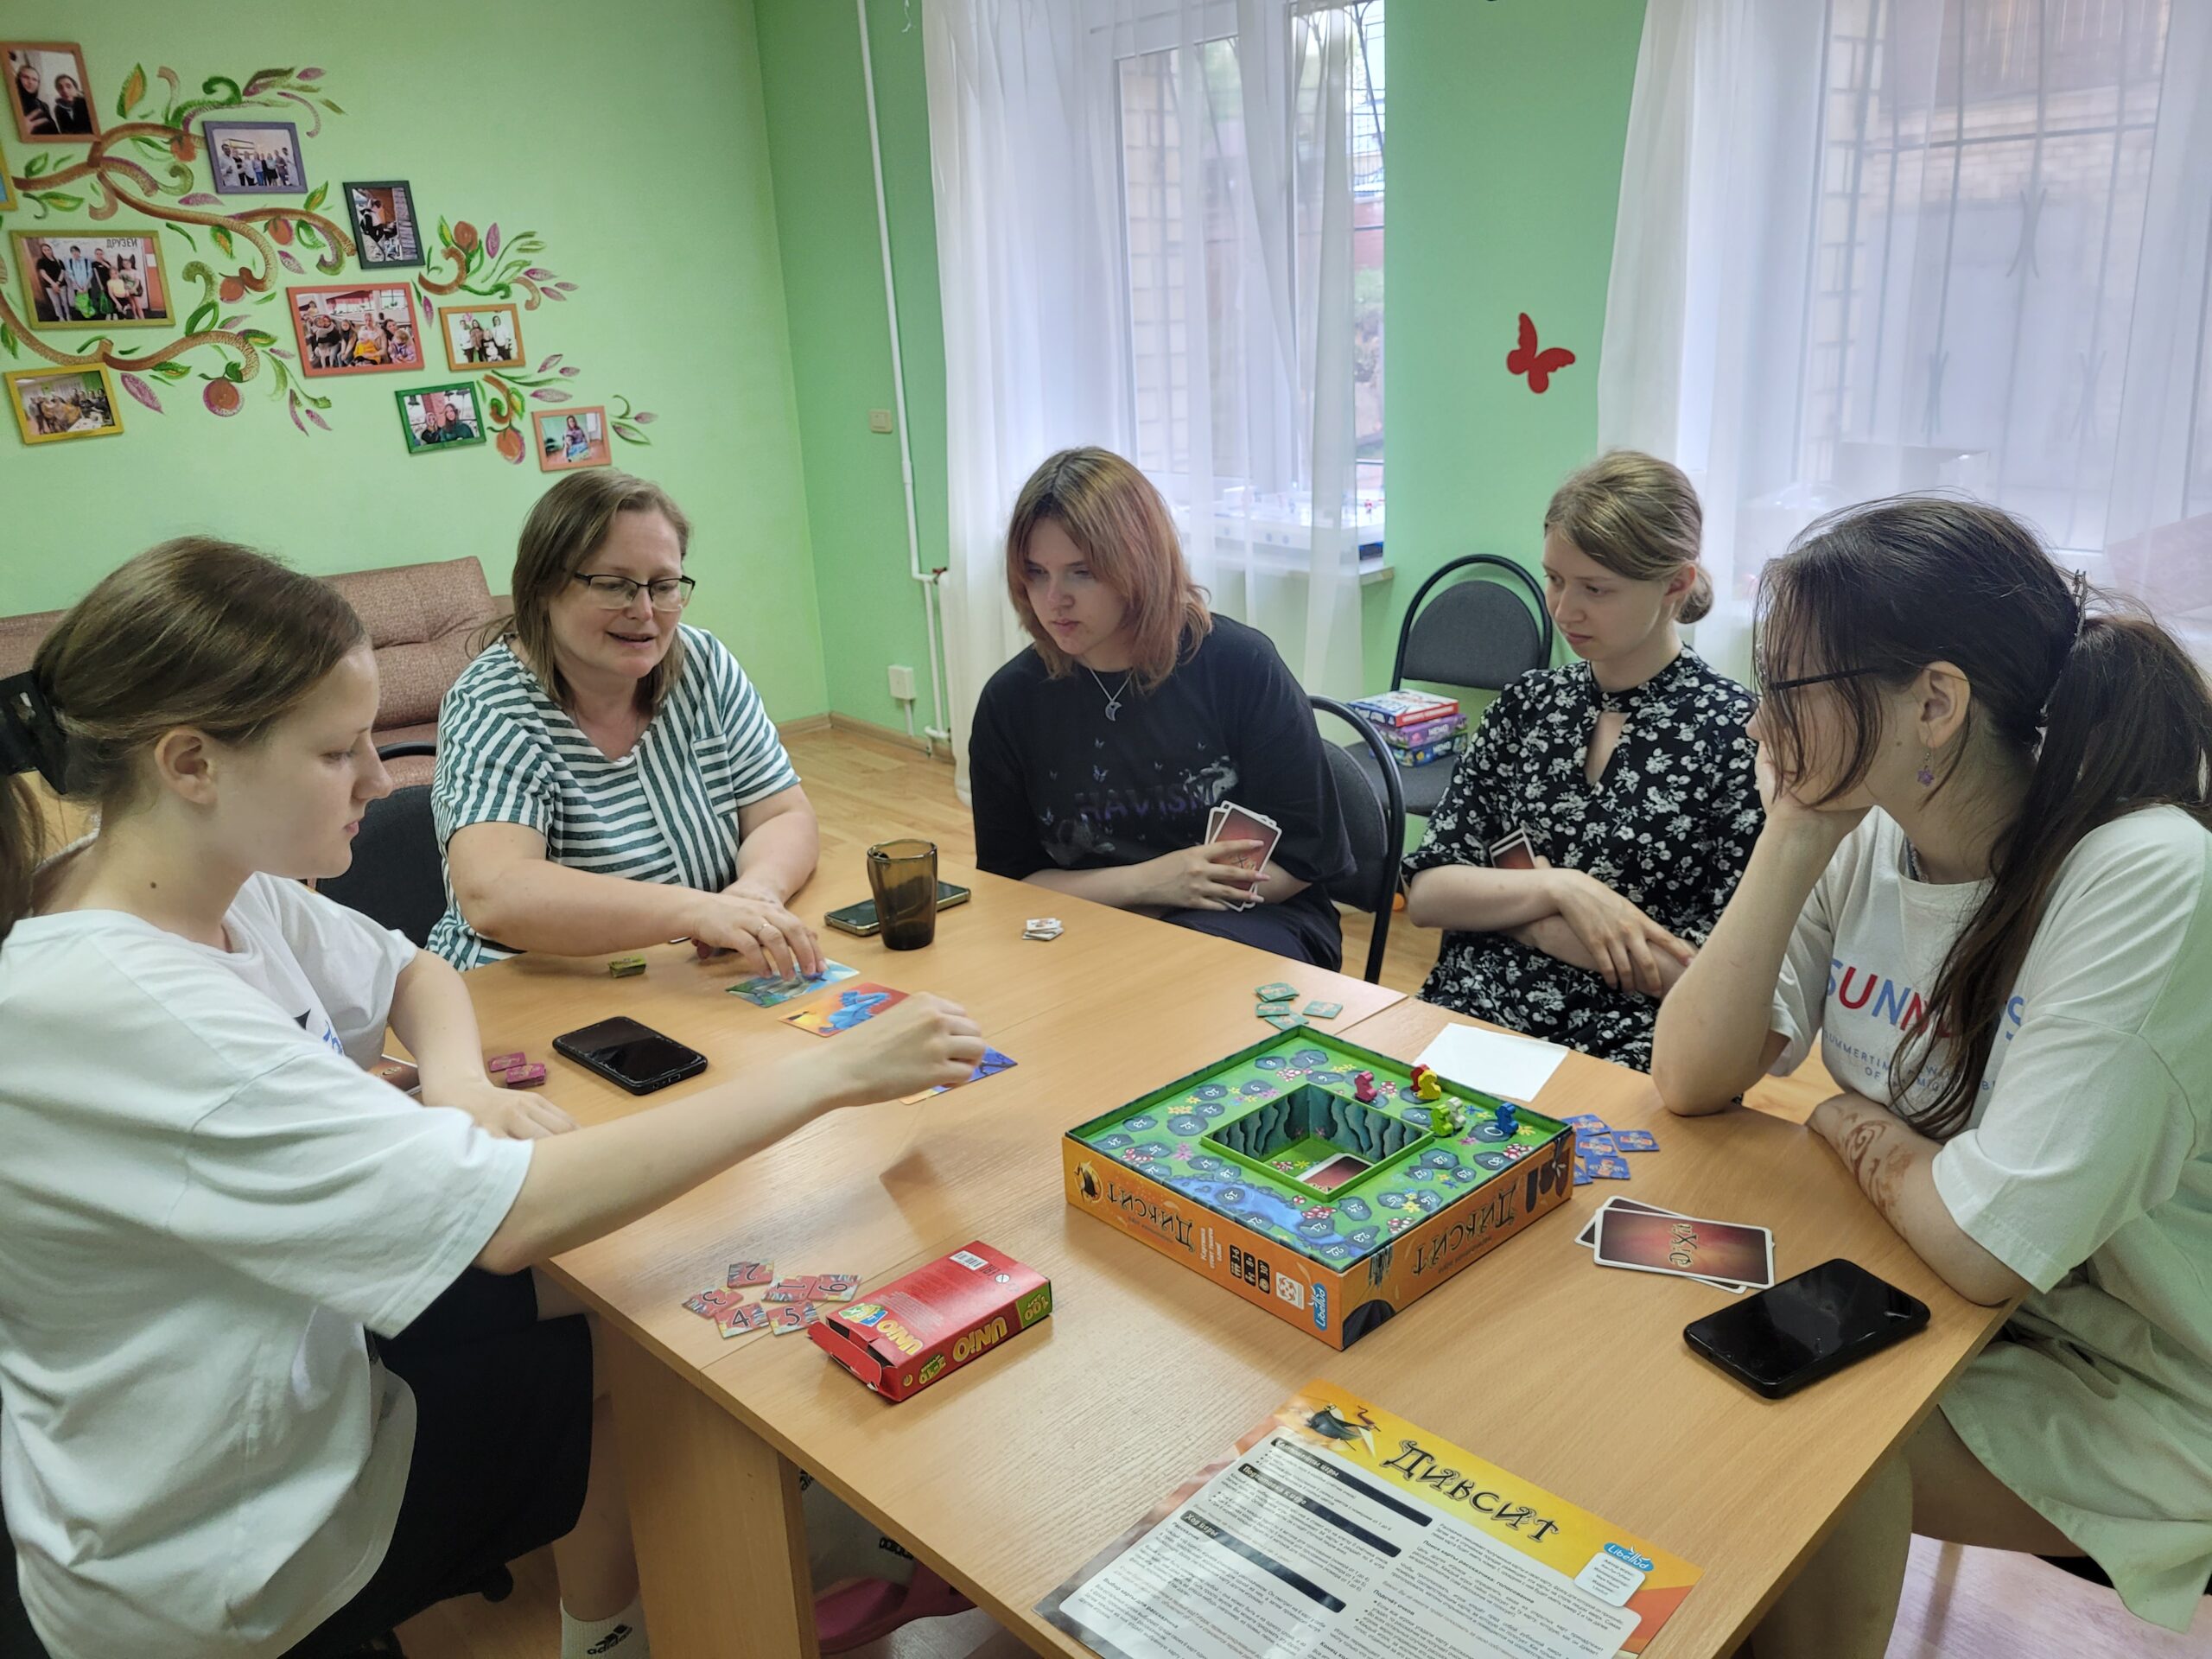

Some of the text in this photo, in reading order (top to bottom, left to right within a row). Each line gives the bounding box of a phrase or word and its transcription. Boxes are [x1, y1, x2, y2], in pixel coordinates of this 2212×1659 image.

[1866, 1066, 1881, 1080] OF
[1205, 1088, 1220, 1096] 10
[1134, 1119, 1147, 1128] 13
[1180, 1121, 1195, 1129] 12
[1484, 1126, 1503, 1136] 0
[1149, 1145, 1161, 1154] 15
[1433, 1155, 1448, 1165] 28
[1488, 1157, 1503, 1166] 30
[1220, 1170, 1234, 1179] 18
[1414, 1169, 1427, 1179] 27
[1457, 1169, 1471, 1179] 29
[1224, 1191, 1238, 1200] 19
[1421, 1196, 1436, 1205] 26
[1387, 1196, 1402, 1206] 25
[1347, 1204, 1363, 1212] 24
[1107, 1182, 1195, 1252] Диксит
[1310, 1222, 1327, 1232] 21
[1412, 1181, 1518, 1275] Диксит
[1354, 1232, 1370, 1242] 23
[1231, 1247, 1240, 1261] 3-6
[1326, 1246, 1344, 1256] 22
[746, 1262, 760, 1281] 2
[776, 1281, 805, 1290] 1
[702, 1290, 727, 1306] 3
[1313, 1287, 1326, 1327] Libellud
[732, 1309, 749, 1327] 4
[785, 1306, 801, 1326] 5
[1380, 1439, 1560, 1543] Диксит
[1184, 1512, 1219, 1537] Ход игры
[1608, 1543, 1649, 1569] Libellud
